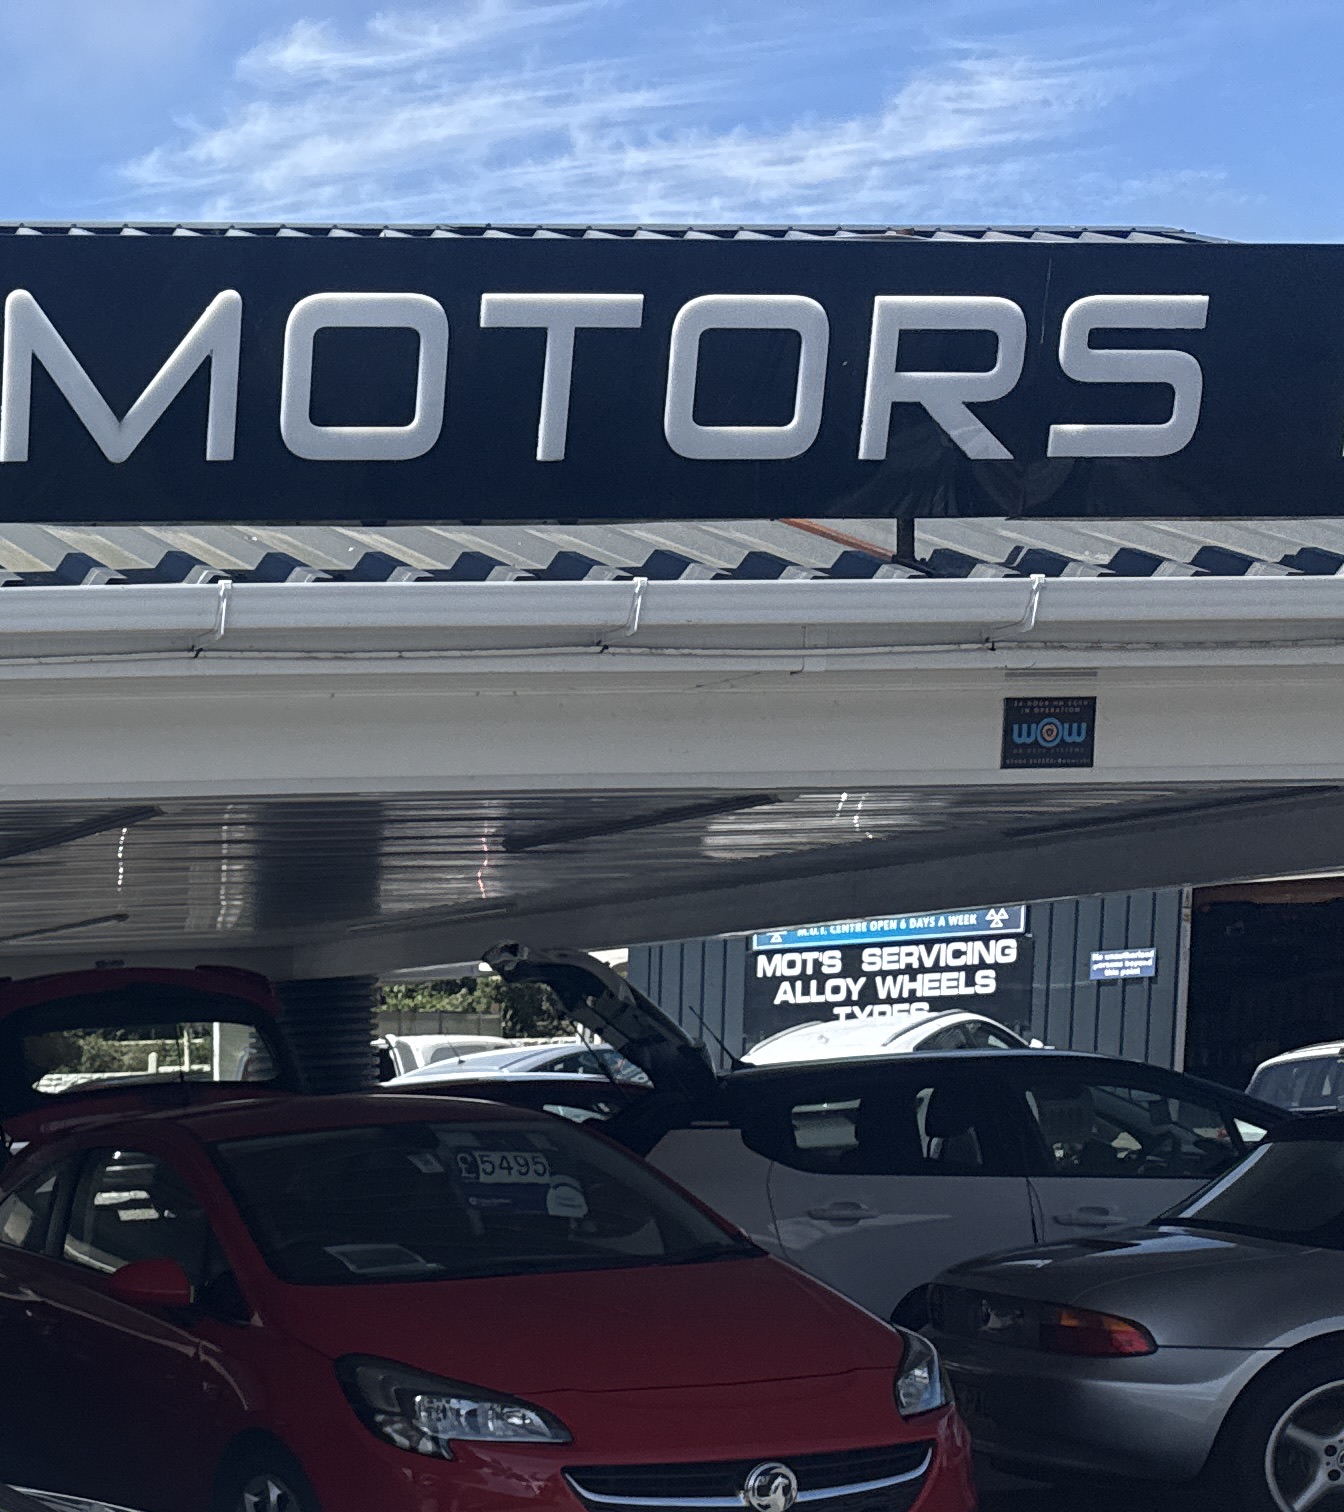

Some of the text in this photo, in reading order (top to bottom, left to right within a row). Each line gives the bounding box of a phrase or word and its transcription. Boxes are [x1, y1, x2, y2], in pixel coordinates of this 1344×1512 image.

[829, 922, 867, 935] CENTRE
[869, 919, 898, 932] OPEN
[899, 919, 907, 930] 6
[909, 916, 936, 929] DAYS
[938, 915, 946, 927] A
[948, 913, 977, 926] WEEK
[756, 938, 1017, 978] MOT'S SERVICING
[773, 969, 996, 1005] ALLOY WHEELS
[456, 1152, 549, 1178] £5495
